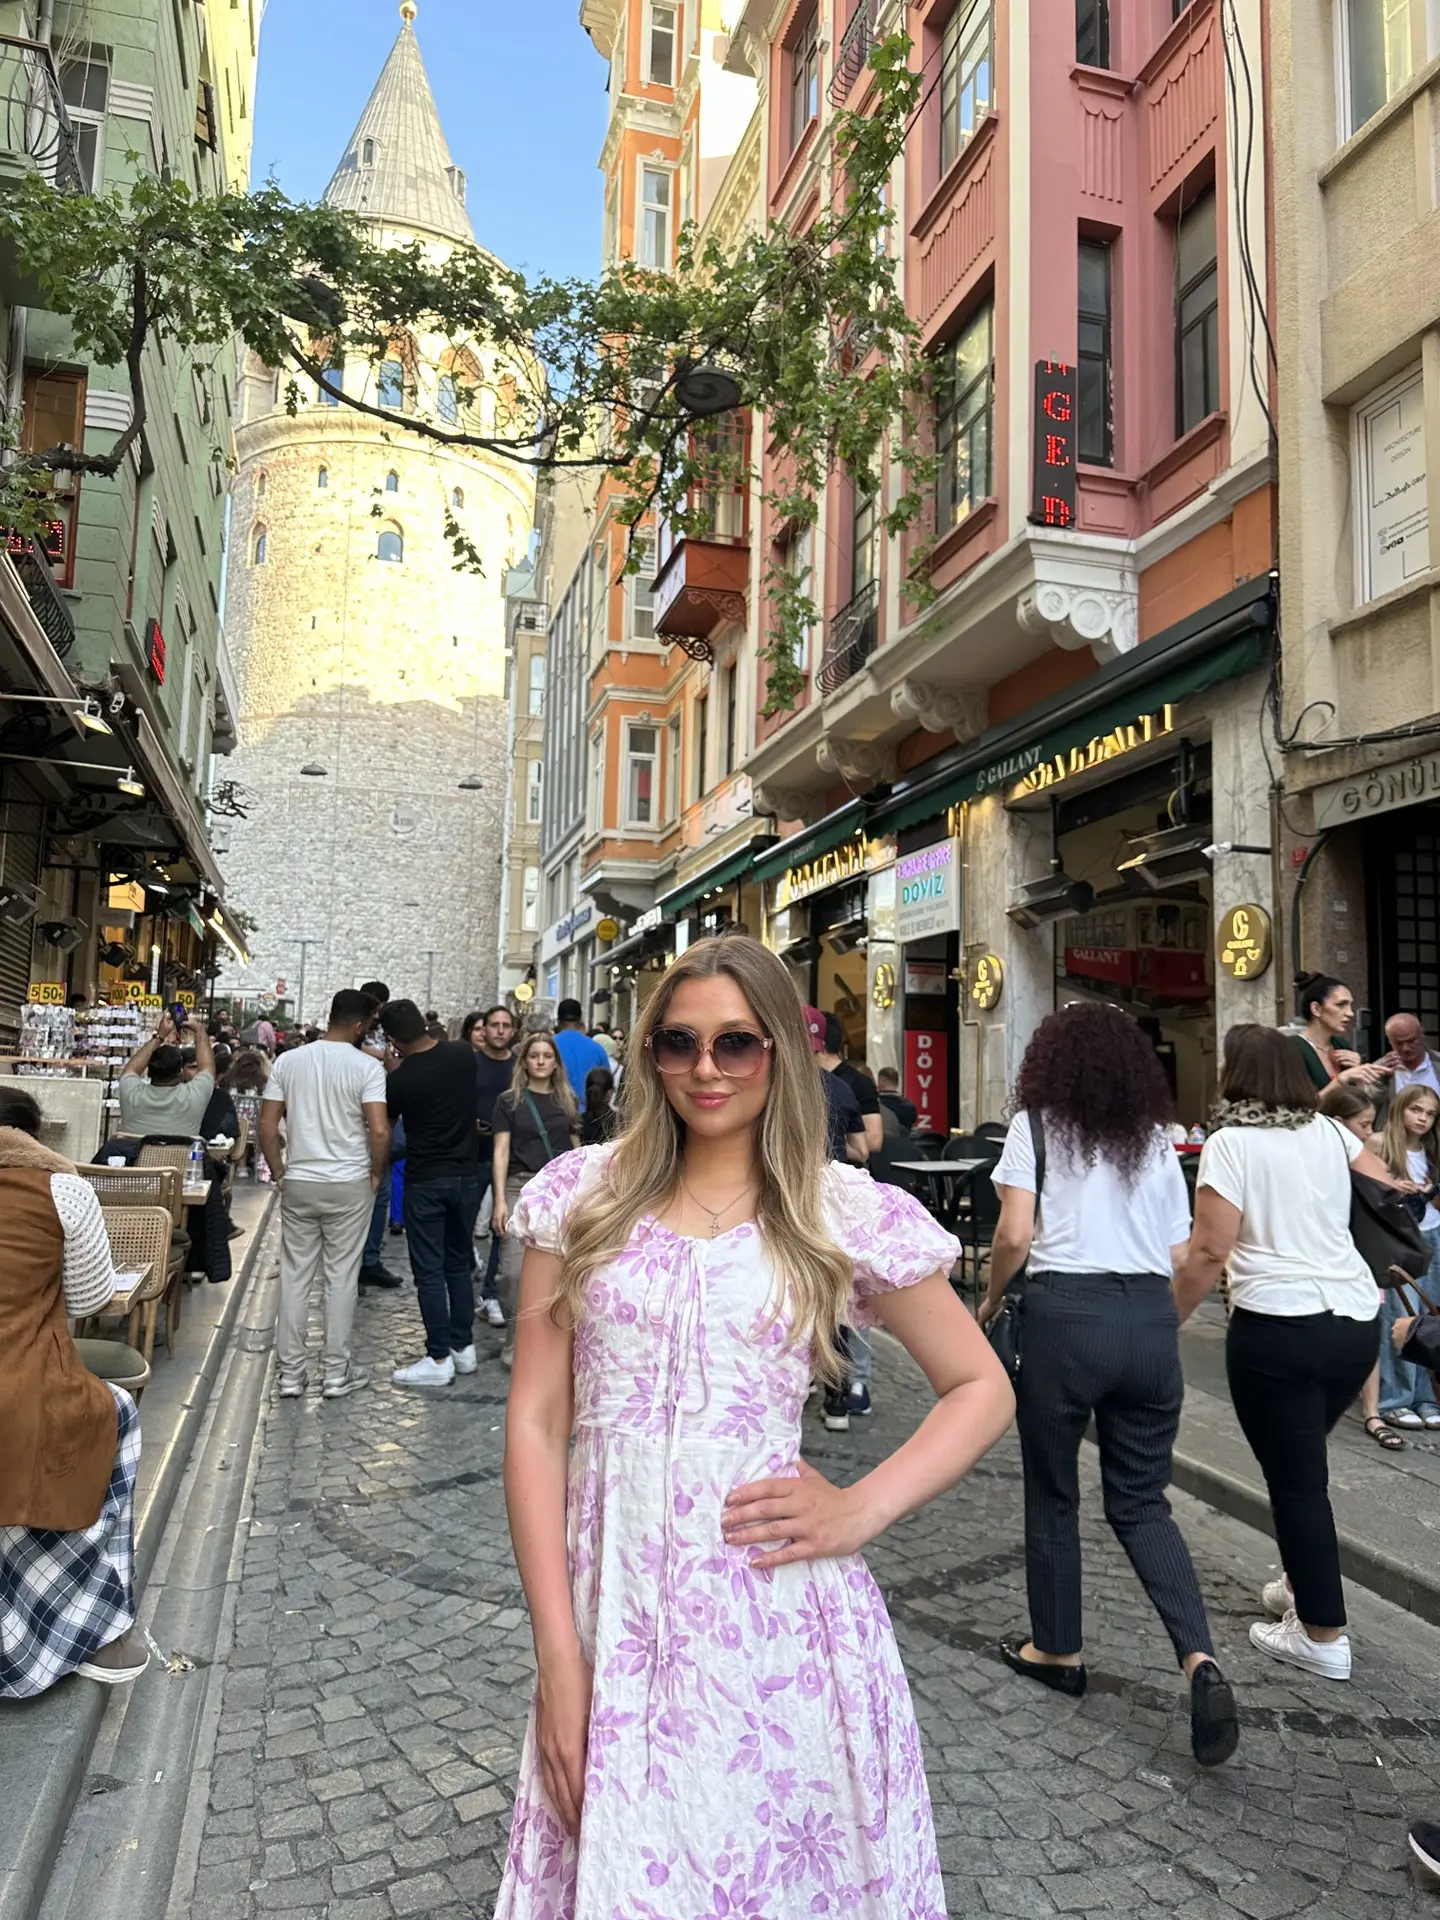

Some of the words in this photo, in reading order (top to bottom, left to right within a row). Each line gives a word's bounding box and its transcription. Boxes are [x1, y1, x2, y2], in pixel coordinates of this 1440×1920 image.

[1382, 424, 1423, 453] ARCHITECTURE
[1390, 446, 1412, 463] DESIGN
[987, 745, 1043, 785] GALLANT
[903, 871, 944, 905] DÖVİZ
[1073, 948, 1121, 966] GALLANT
[917, 1035, 933, 1128] DÖVİZ
